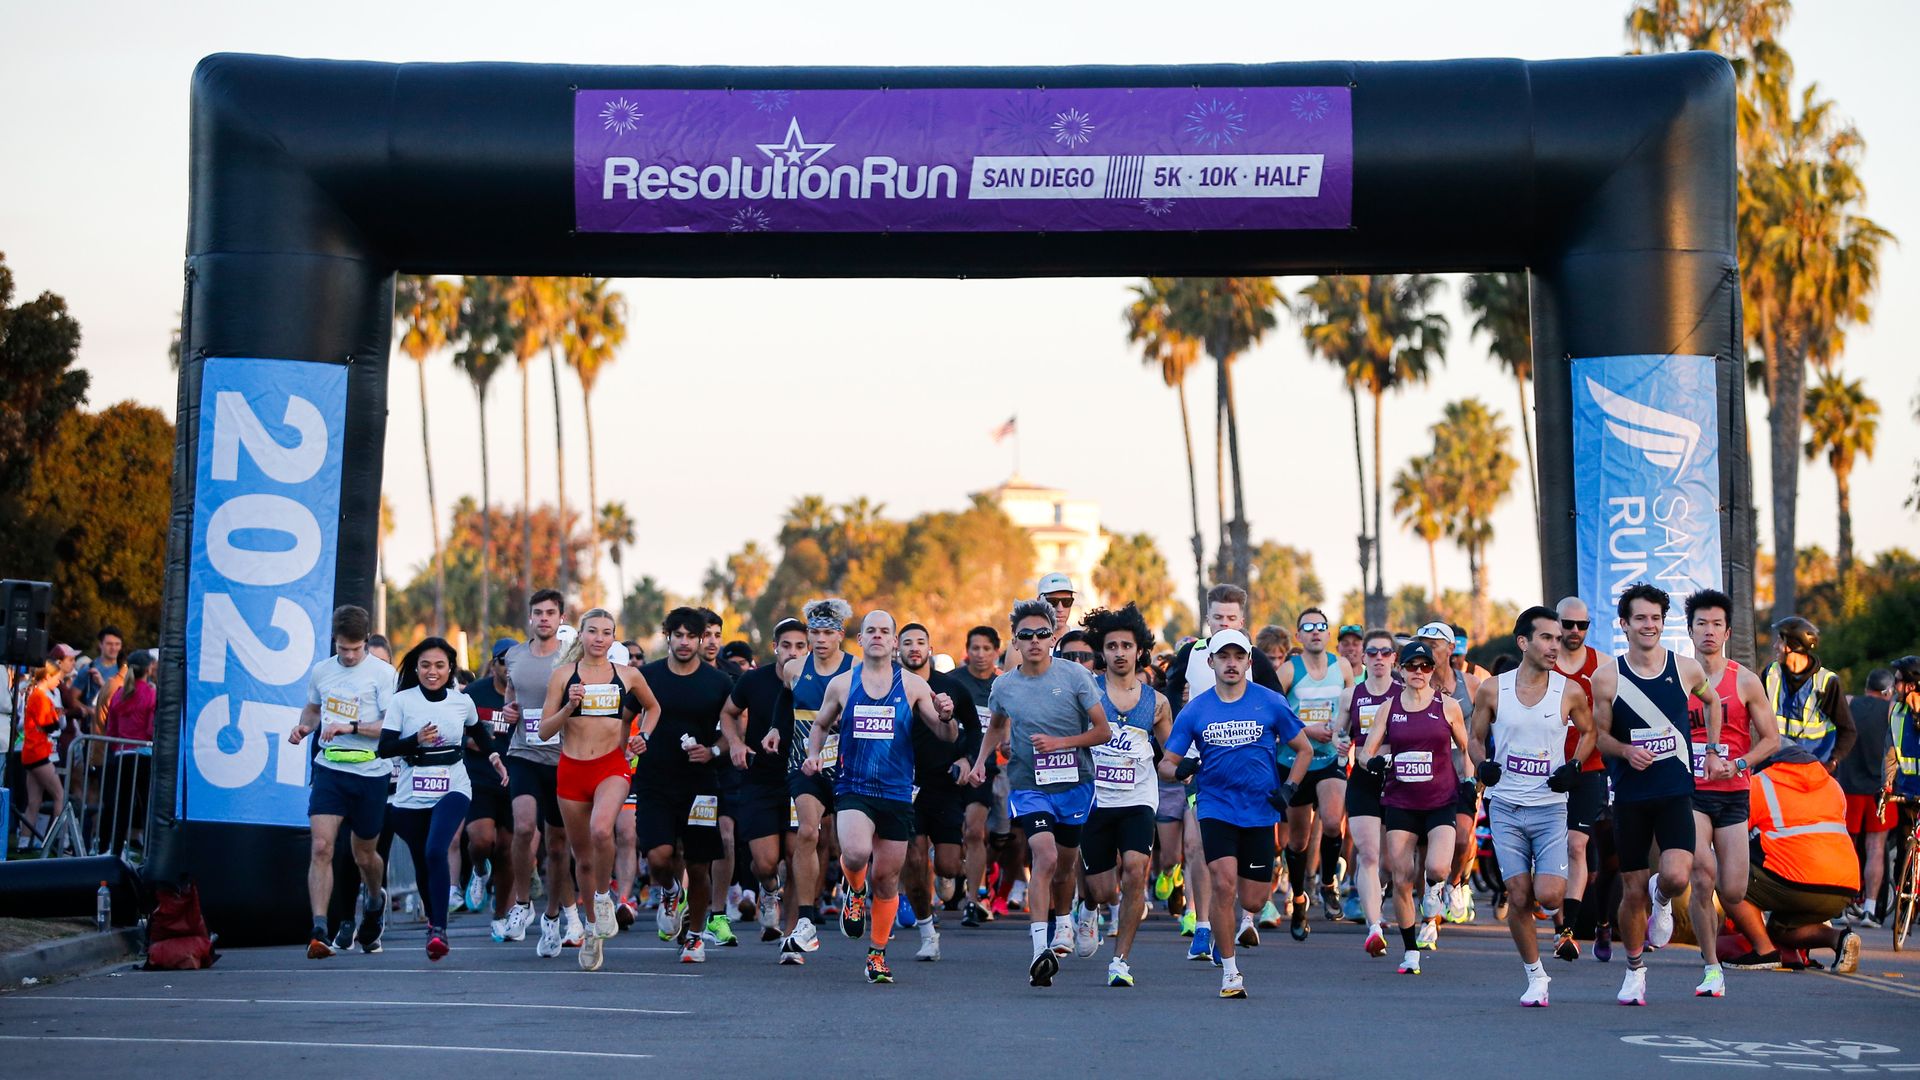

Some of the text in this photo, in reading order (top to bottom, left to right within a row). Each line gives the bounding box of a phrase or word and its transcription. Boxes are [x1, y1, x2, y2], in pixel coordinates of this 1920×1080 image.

[602, 155, 958, 200] ResolutionRun
[982, 167, 1095, 188] SAN DIEGO
[1153, 165, 1311, 187] 5K 10K HALF
[1652, 496, 1690, 580] SAN
[193, 391, 329, 788] 2025
[594, 695, 617, 707] 1421
[336, 702, 357, 716] 1337
[866, 718, 893, 731] 2344
[1203, 727, 1262, 741] SAN MARCOS
[1104, 732, 1132, 751] cla
[1645, 738, 1675, 753] 2298
[1048, 753, 1075, 767] 2120
[1519, 760, 1548, 774] 2014
[1107, 768, 1133, 781] 2436
[1405, 763, 1431, 774] 2500
[424, 778, 448, 790] 2041
